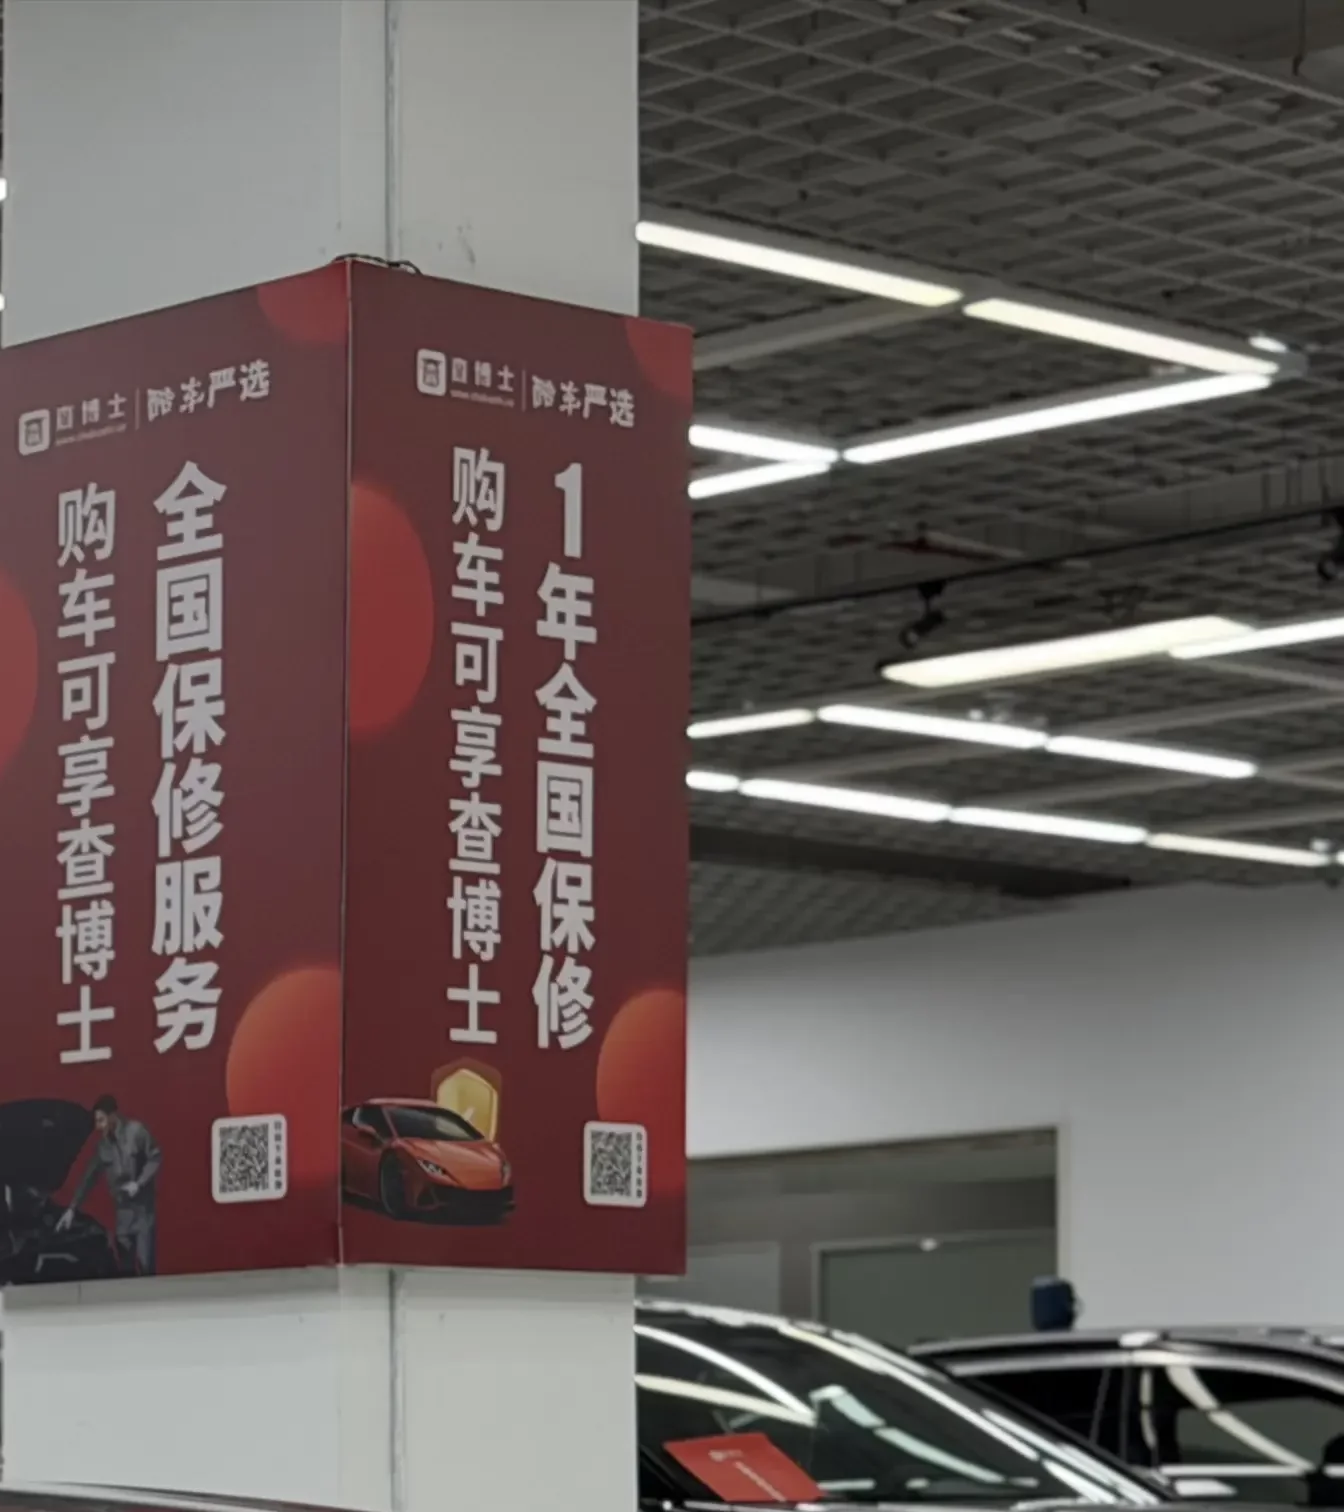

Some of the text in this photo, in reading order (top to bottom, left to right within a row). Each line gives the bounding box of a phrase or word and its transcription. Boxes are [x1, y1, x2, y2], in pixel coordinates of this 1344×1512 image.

[56, 482, 116, 1063] 购车可享查博士
[152, 460, 227, 1053] 全国保修服务
[447, 447, 505, 1044] 购车可享查博士
[533, 462, 597, 1049] 1年全国保修
